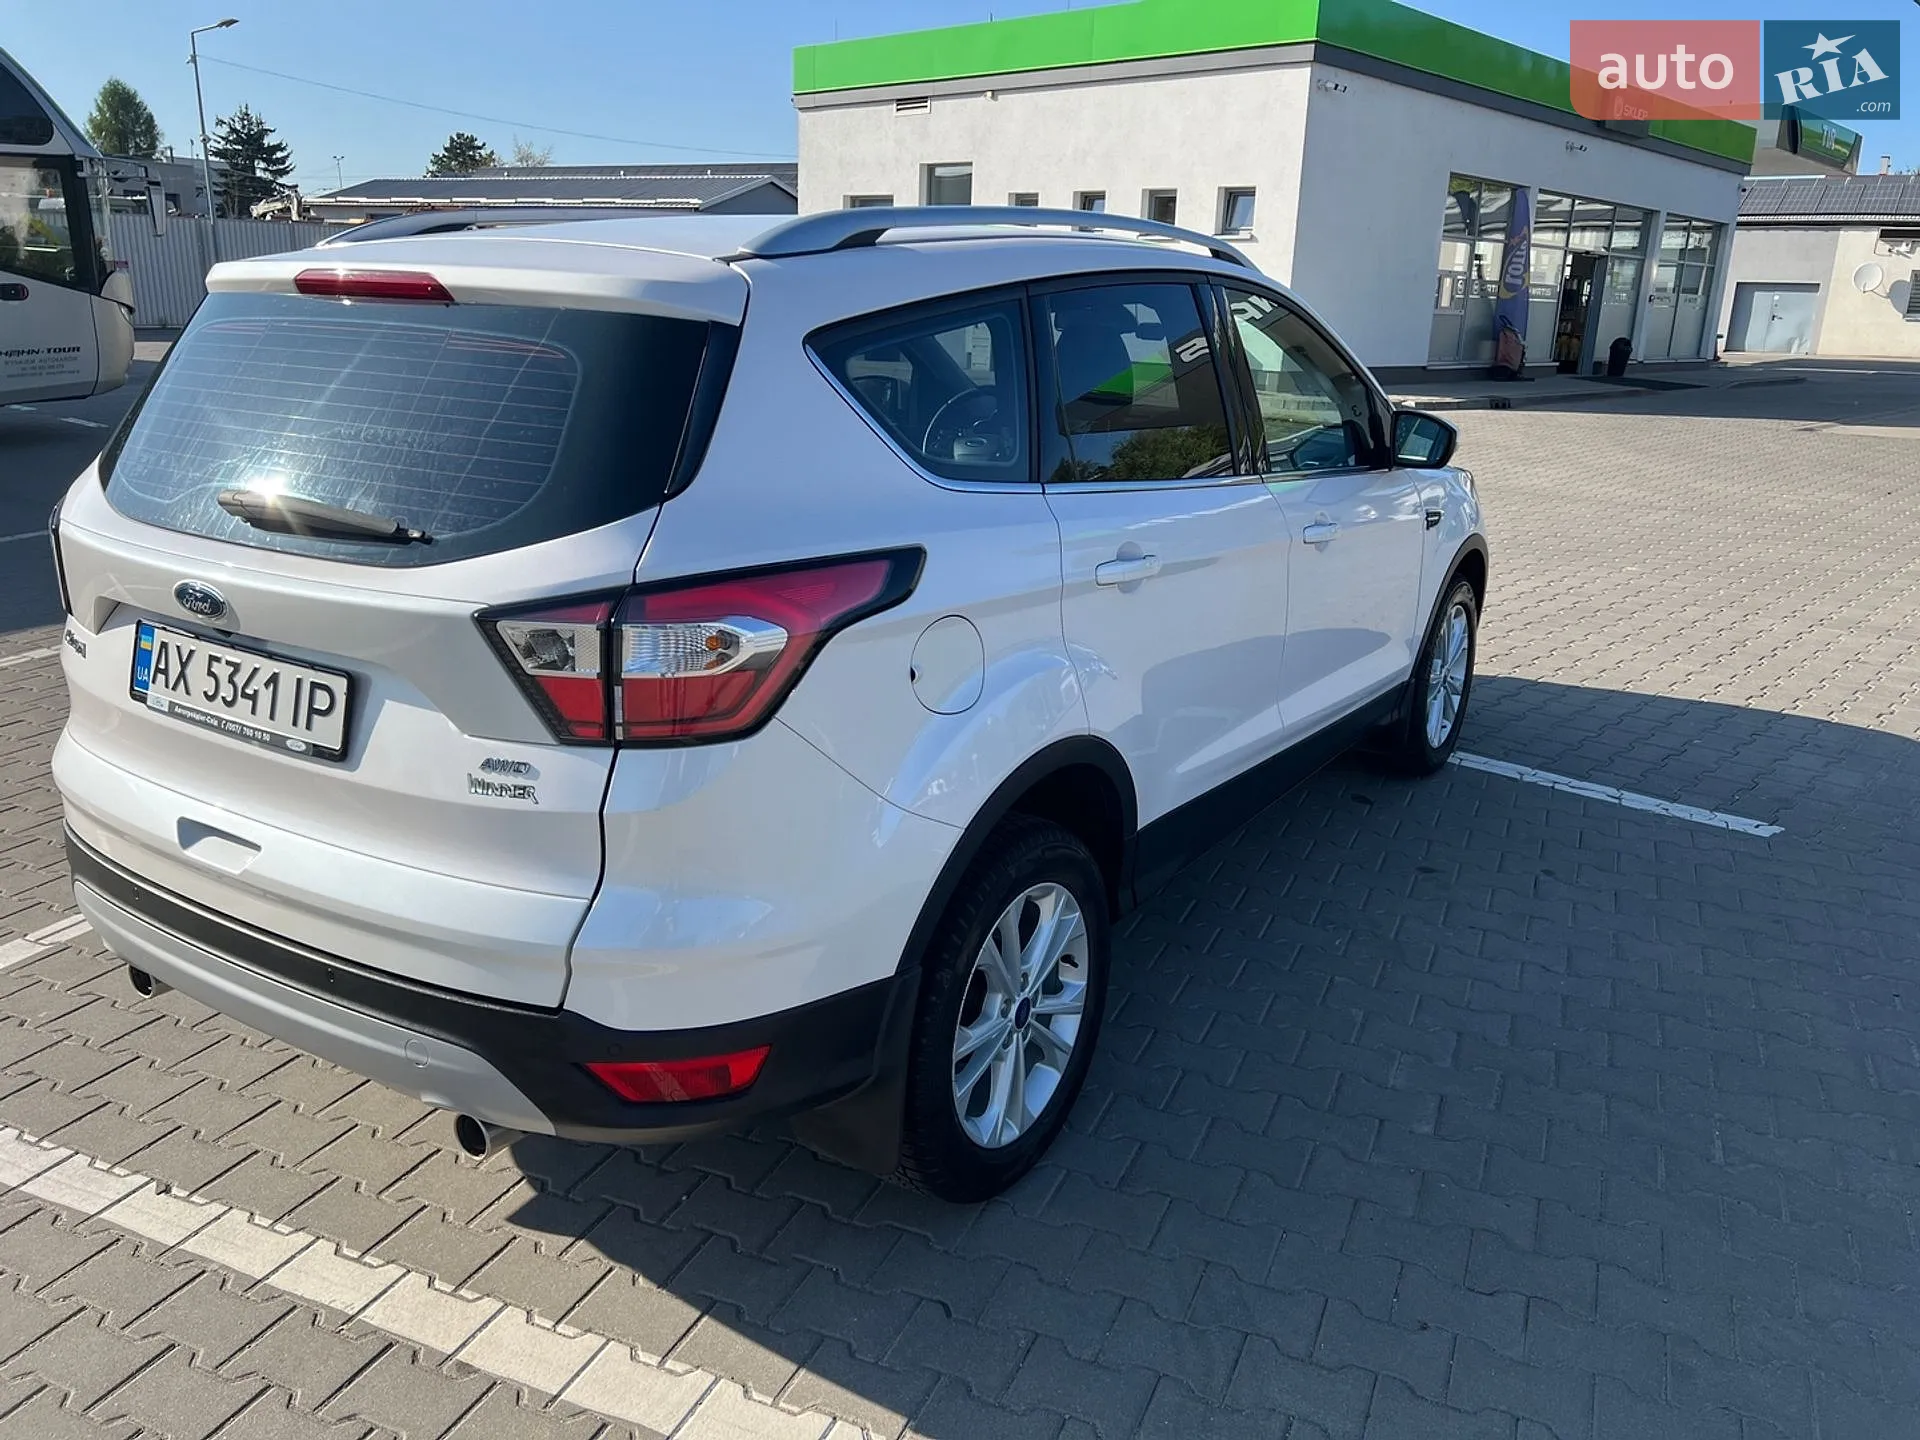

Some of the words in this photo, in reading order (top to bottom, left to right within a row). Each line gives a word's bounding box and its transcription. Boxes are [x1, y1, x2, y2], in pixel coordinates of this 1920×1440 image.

[1622, 103, 1648, 121] SKLEP
[182, 589, 212, 613] Ford
[137, 665, 150, 681] UA
[151, 639, 196, 697] AX
[203, 653, 281, 722] 5341
[292, 675, 335, 731] IP
[479, 757, 532, 776] AWD
[467, 772, 539, 805] WINNER
